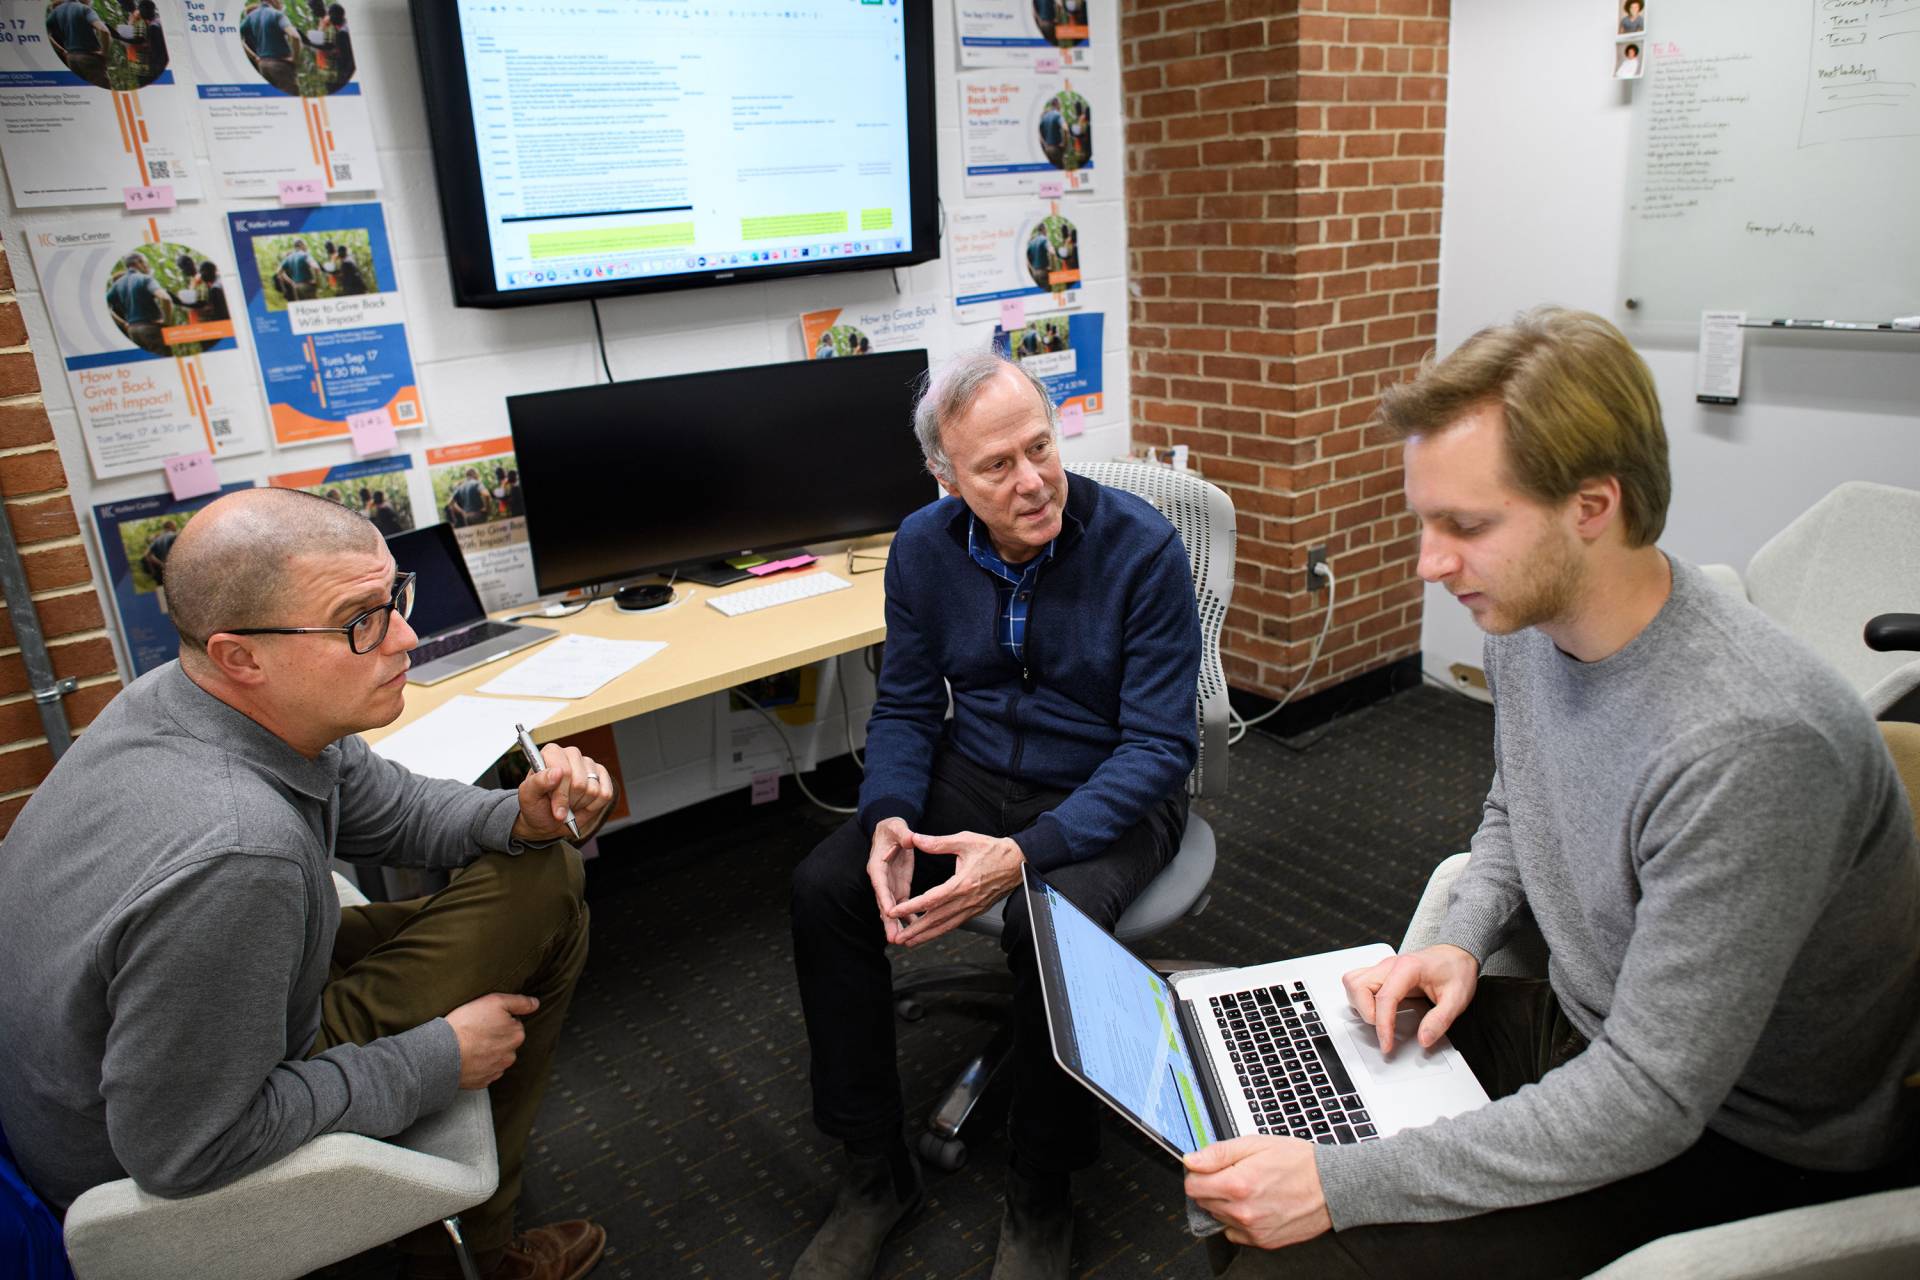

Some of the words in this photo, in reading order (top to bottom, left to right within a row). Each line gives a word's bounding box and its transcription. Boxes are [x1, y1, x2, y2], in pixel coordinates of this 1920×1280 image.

[185, 0, 205, 10] Tue
[188, 12, 209, 24] Sep
[213, 12, 225, 21] 17
[10, 20, 25, 30] 17
[191, 24, 216, 33] 4:30
[219, 26, 237, 35] pm
[17, 35, 40, 45] pm
[968, 96, 986, 104] Back
[55, 234, 80, 243] Keller
[82, 231, 110, 240] Center
[296, 305, 320, 316] How
[323, 302, 334, 312] to
[336, 300, 360, 312] Give
[362, 297, 386, 308] Back
[860, 314, 880, 325] How
[882, 313, 891, 322] to
[893, 309, 914, 320] Give
[916, 306, 937, 316] Back
[345, 353, 365, 365] Sep
[366, 349, 378, 361] 17
[79, 369, 112, 384] How
[116, 368, 130, 379] to
[350, 365, 368, 376] PM
[84, 382, 120, 399] Give
[122, 378, 156, 392] Back
[88, 400, 118, 414] with
[122, 390, 172, 411] Impact!
